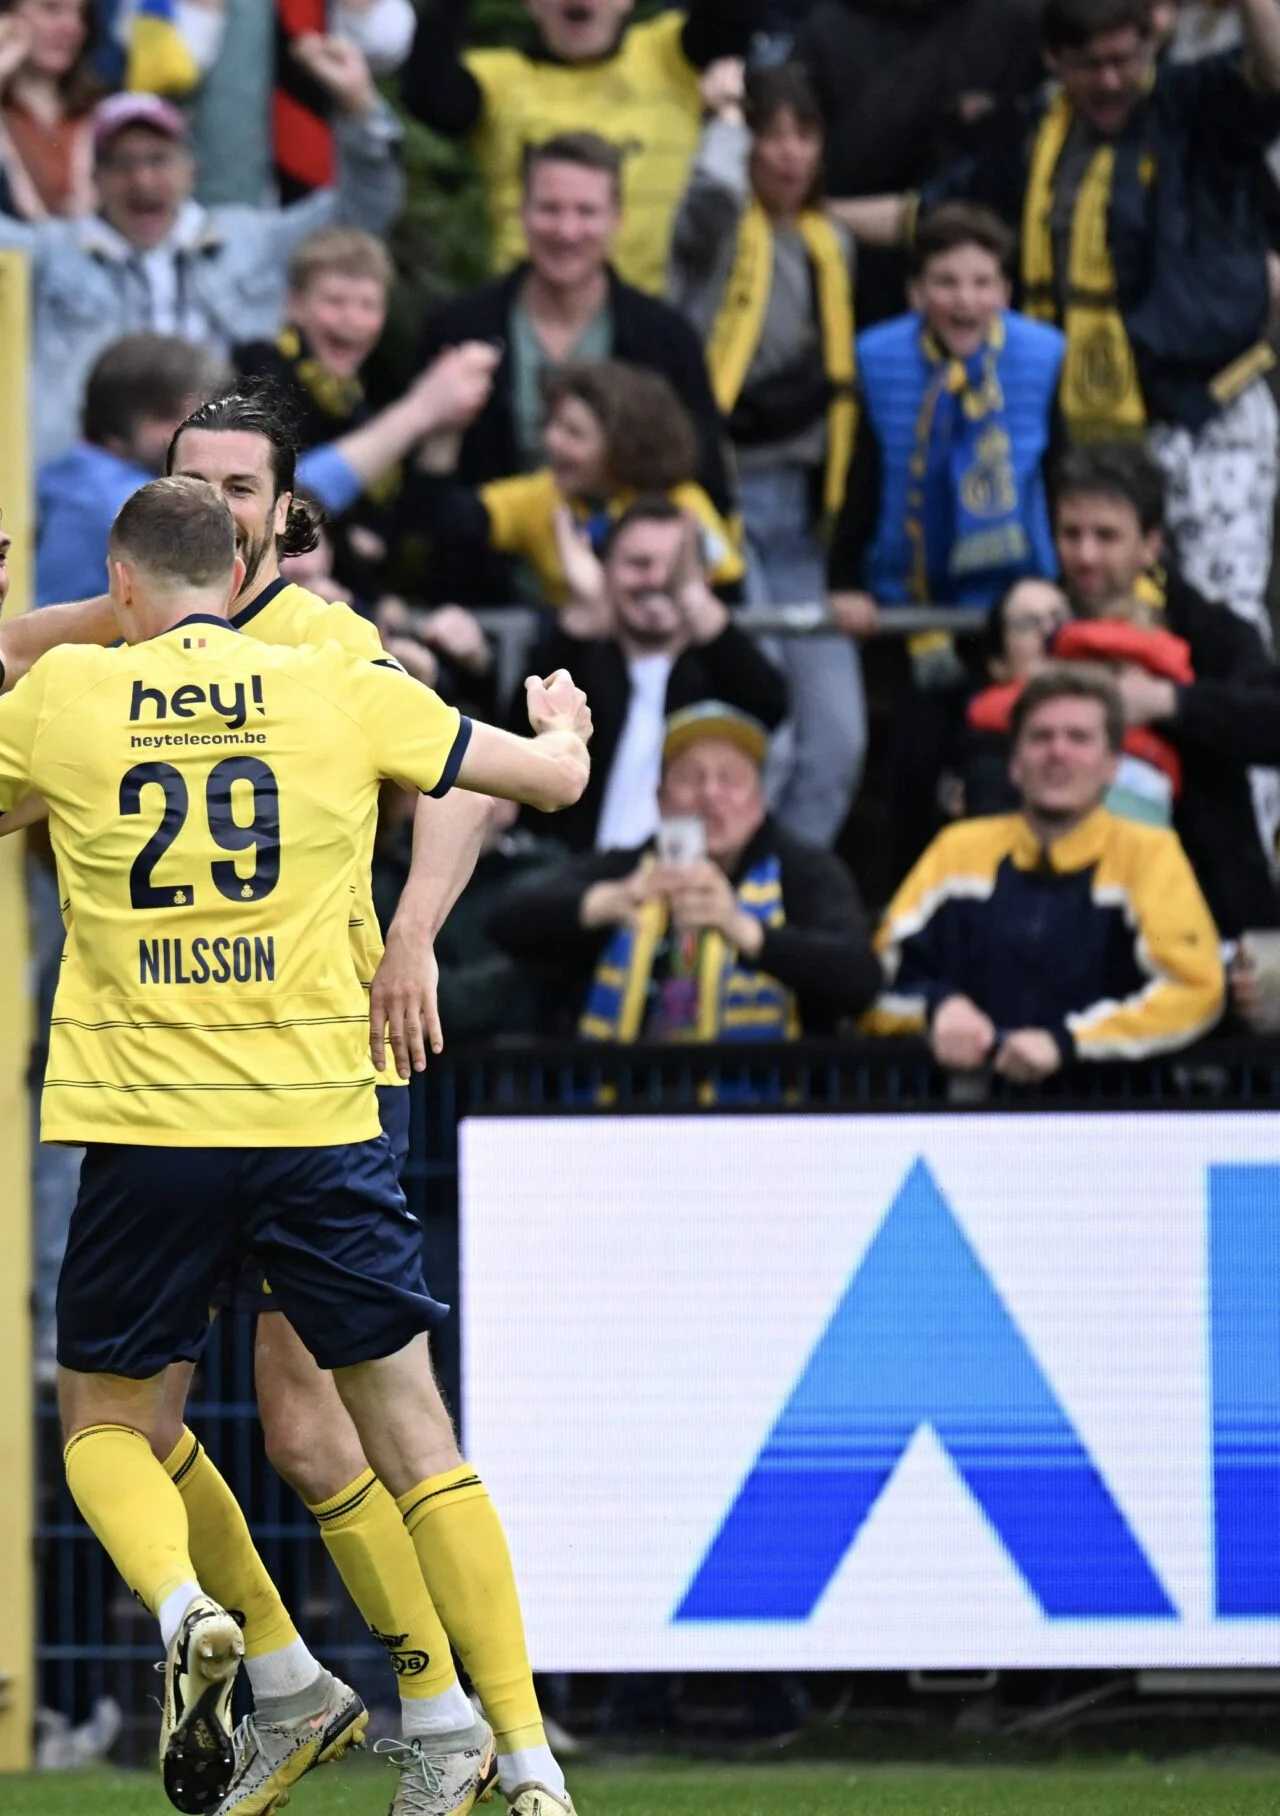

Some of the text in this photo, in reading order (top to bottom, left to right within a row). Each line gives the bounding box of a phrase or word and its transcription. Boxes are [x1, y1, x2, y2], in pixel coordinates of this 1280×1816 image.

[129, 675, 265, 730] hey!
[130, 731, 266, 748] heytelecom.be
[119, 755, 281, 910] 29
[139, 936, 275, 985] NILSSON
